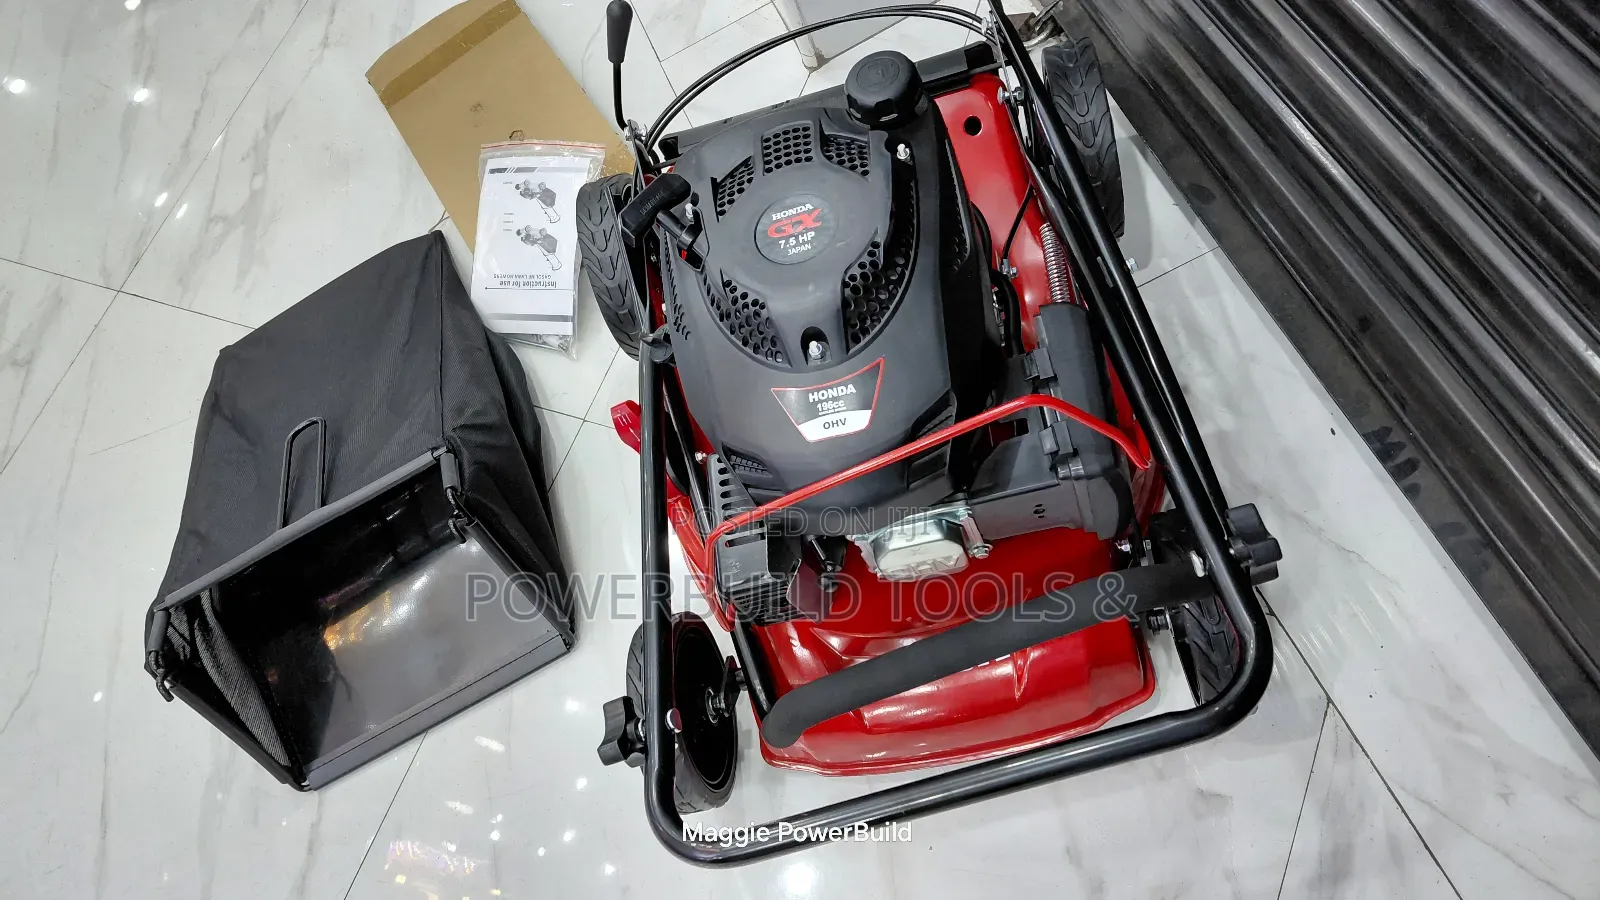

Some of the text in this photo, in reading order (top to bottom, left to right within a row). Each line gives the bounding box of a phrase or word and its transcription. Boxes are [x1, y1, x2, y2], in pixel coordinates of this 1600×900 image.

[771, 203, 815, 220] HONDA
[767, 207, 822, 238] GX
[779, 231, 816, 249] 7.5 HP
[787, 242, 812, 256] JAPAN
[511, 280, 521, 288] for
[522, 280, 557, 288] Instruction
[808, 383, 857, 402] HONDA
[816, 399, 845, 412] 196cc
[823, 417, 847, 430] OHV
